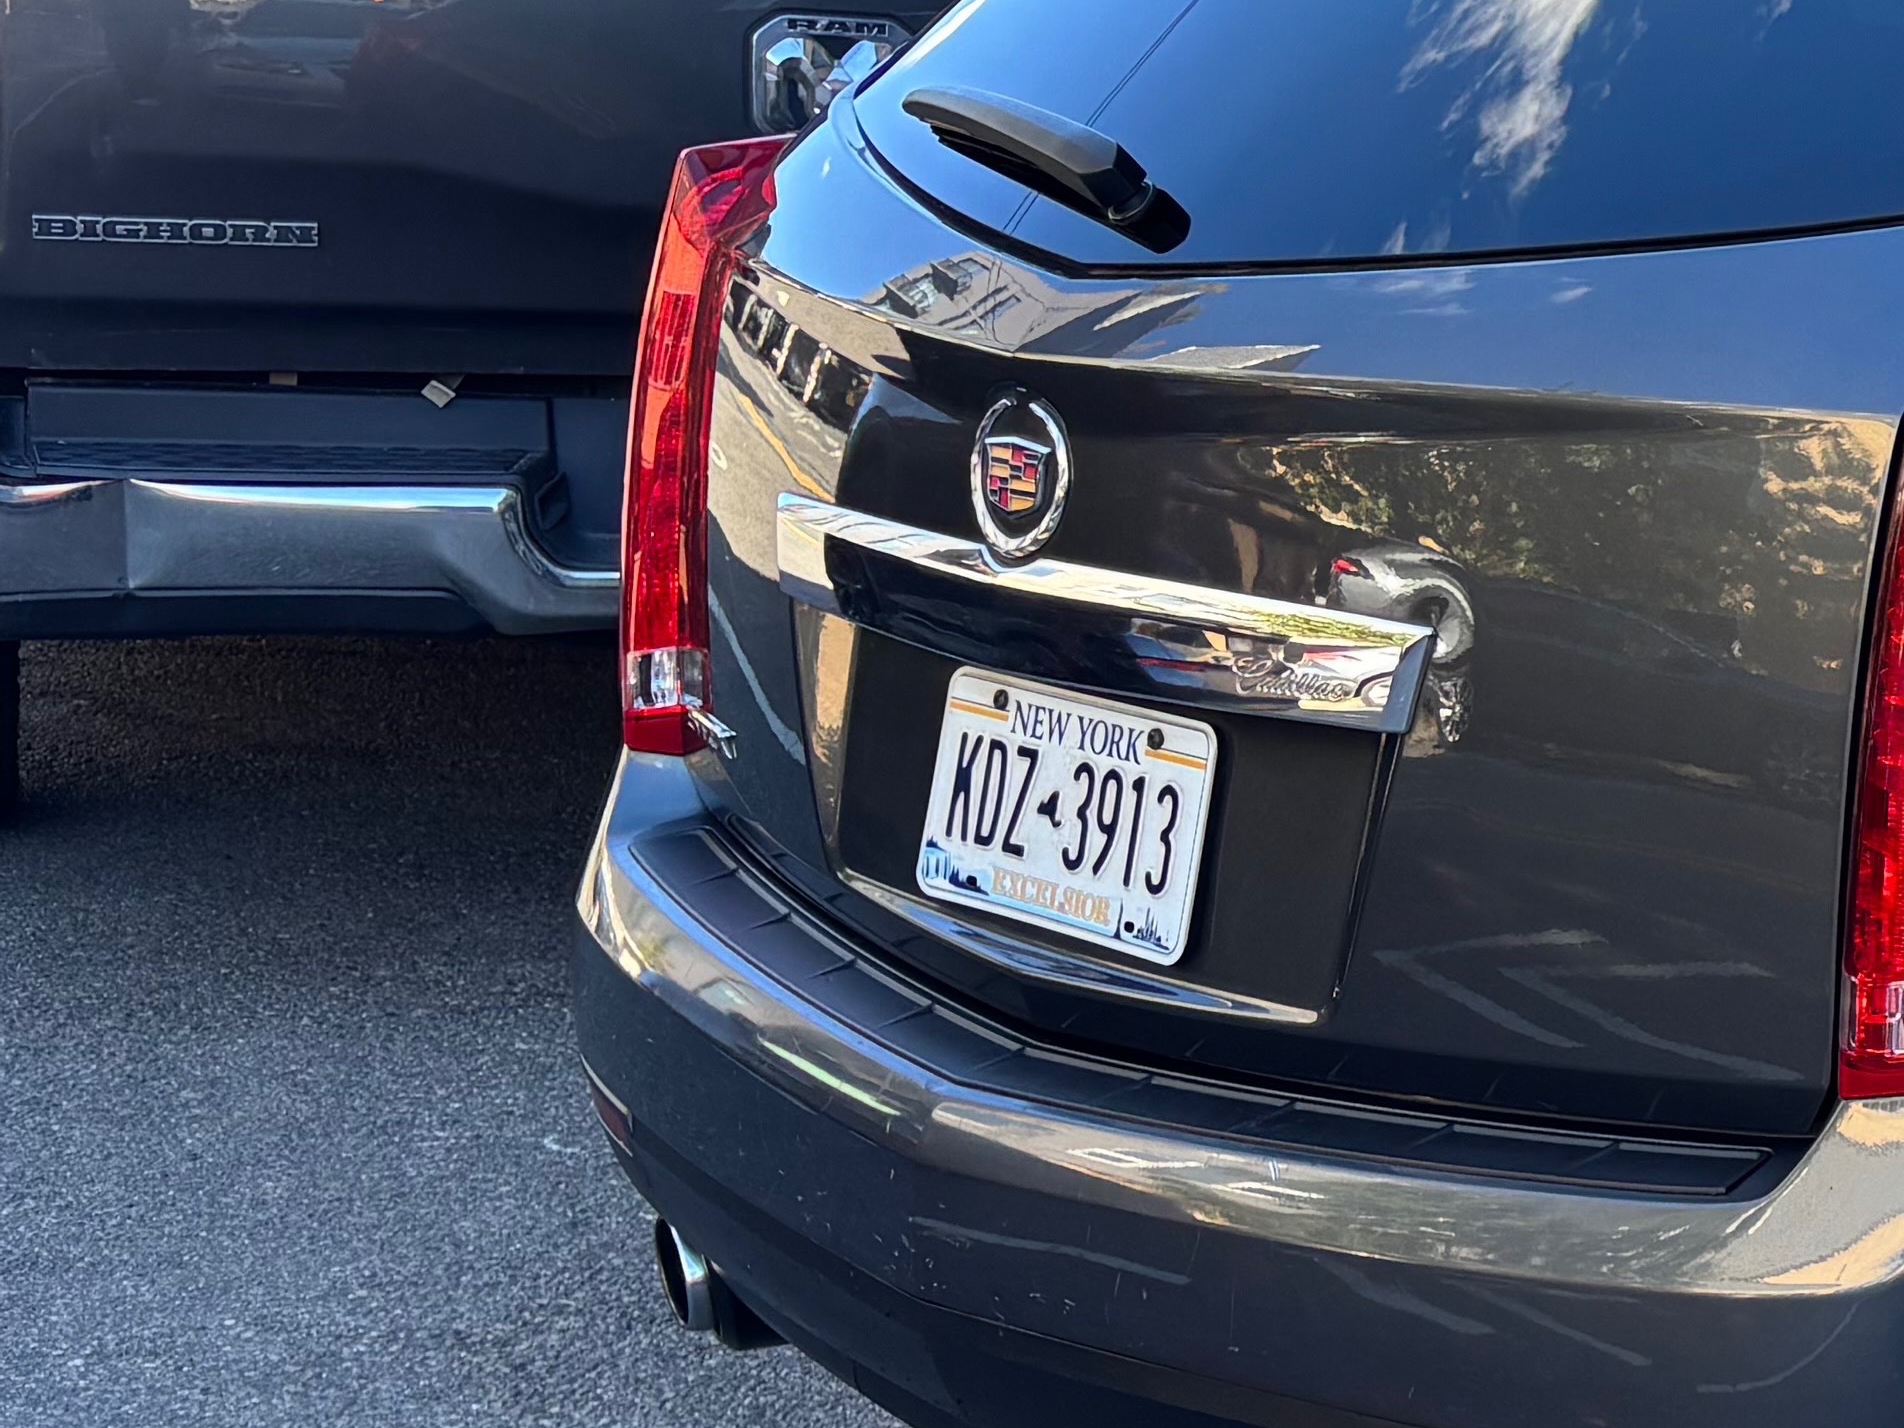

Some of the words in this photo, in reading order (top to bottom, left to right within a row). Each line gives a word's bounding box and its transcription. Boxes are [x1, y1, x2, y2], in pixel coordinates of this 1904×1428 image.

[787, 18, 889, 38] RAM
[32, 215, 318, 247] BIGHORN
[1010, 700, 1072, 744] NEW
[1076, 715, 1145, 765] YORK
[991, 866, 1111, 926] EXCELSIOR
